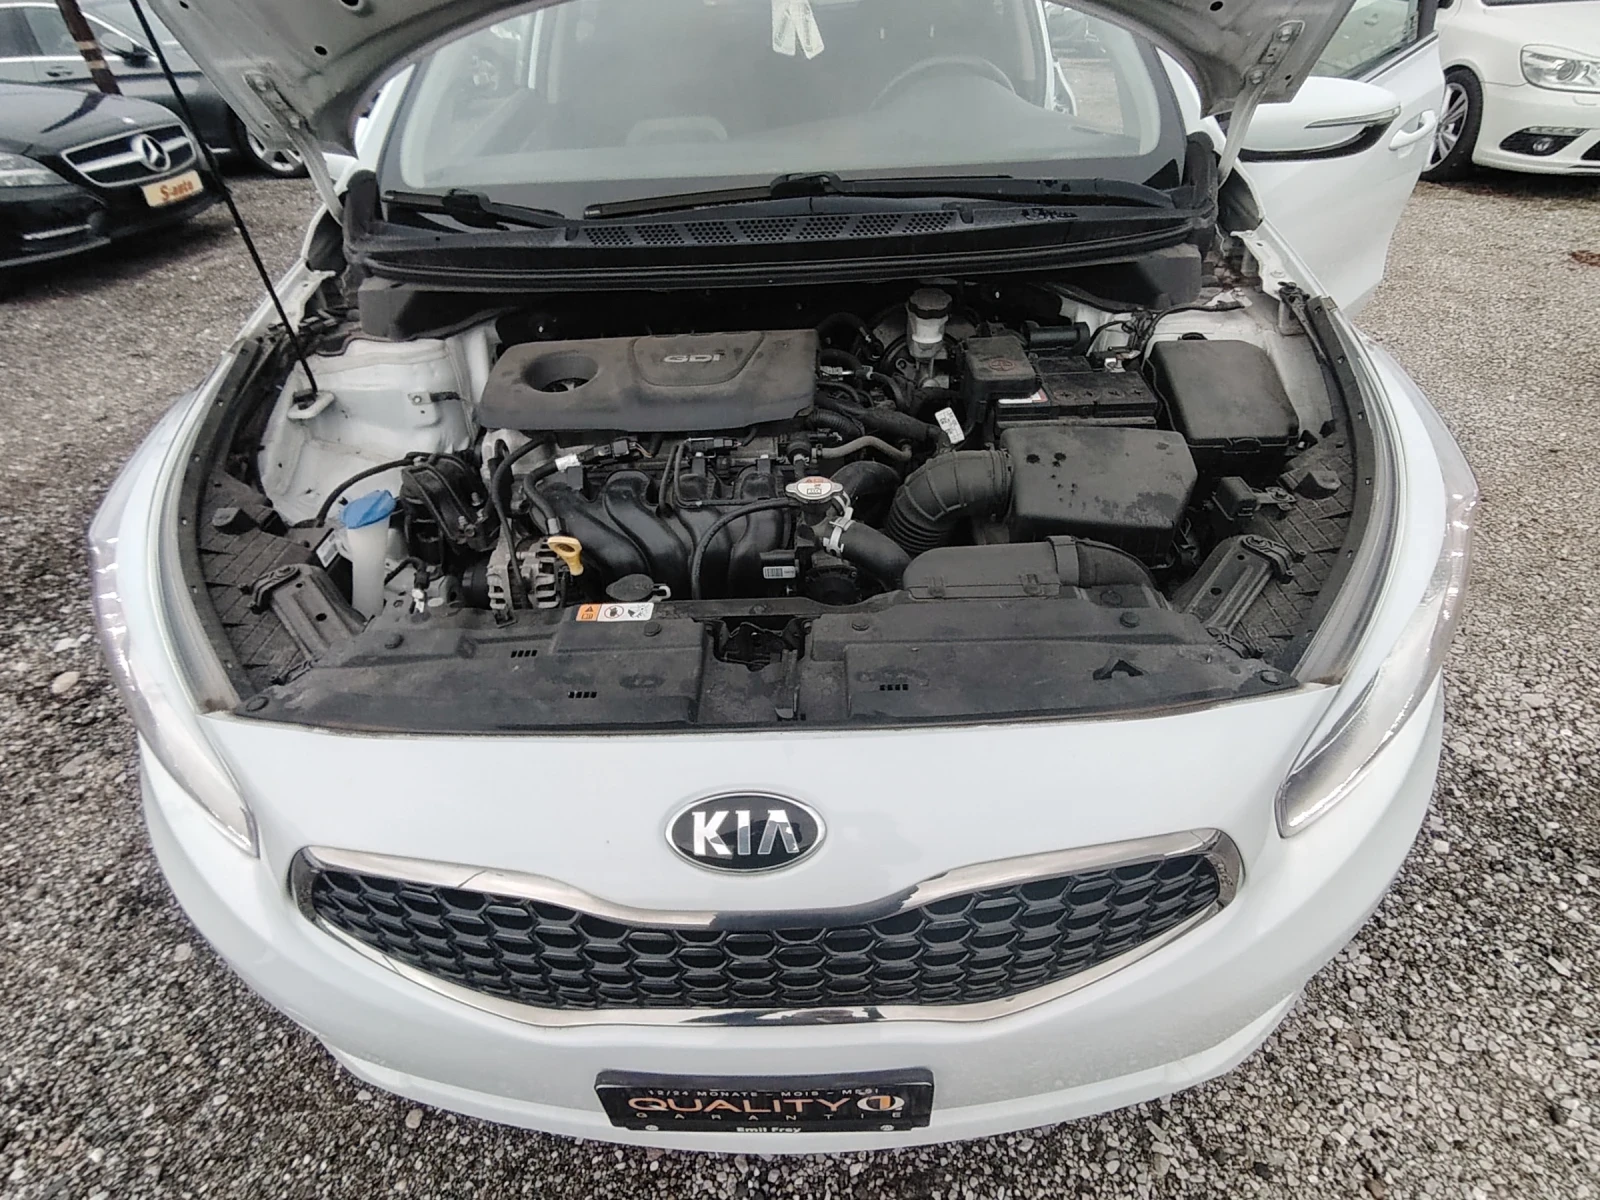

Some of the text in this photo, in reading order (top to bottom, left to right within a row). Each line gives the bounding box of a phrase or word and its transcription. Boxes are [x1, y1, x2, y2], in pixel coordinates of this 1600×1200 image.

[691, 809, 800, 856] KIA
[696, 1090, 758, 1098] MONATE
[628, 1097, 851, 1113] QUALITY
